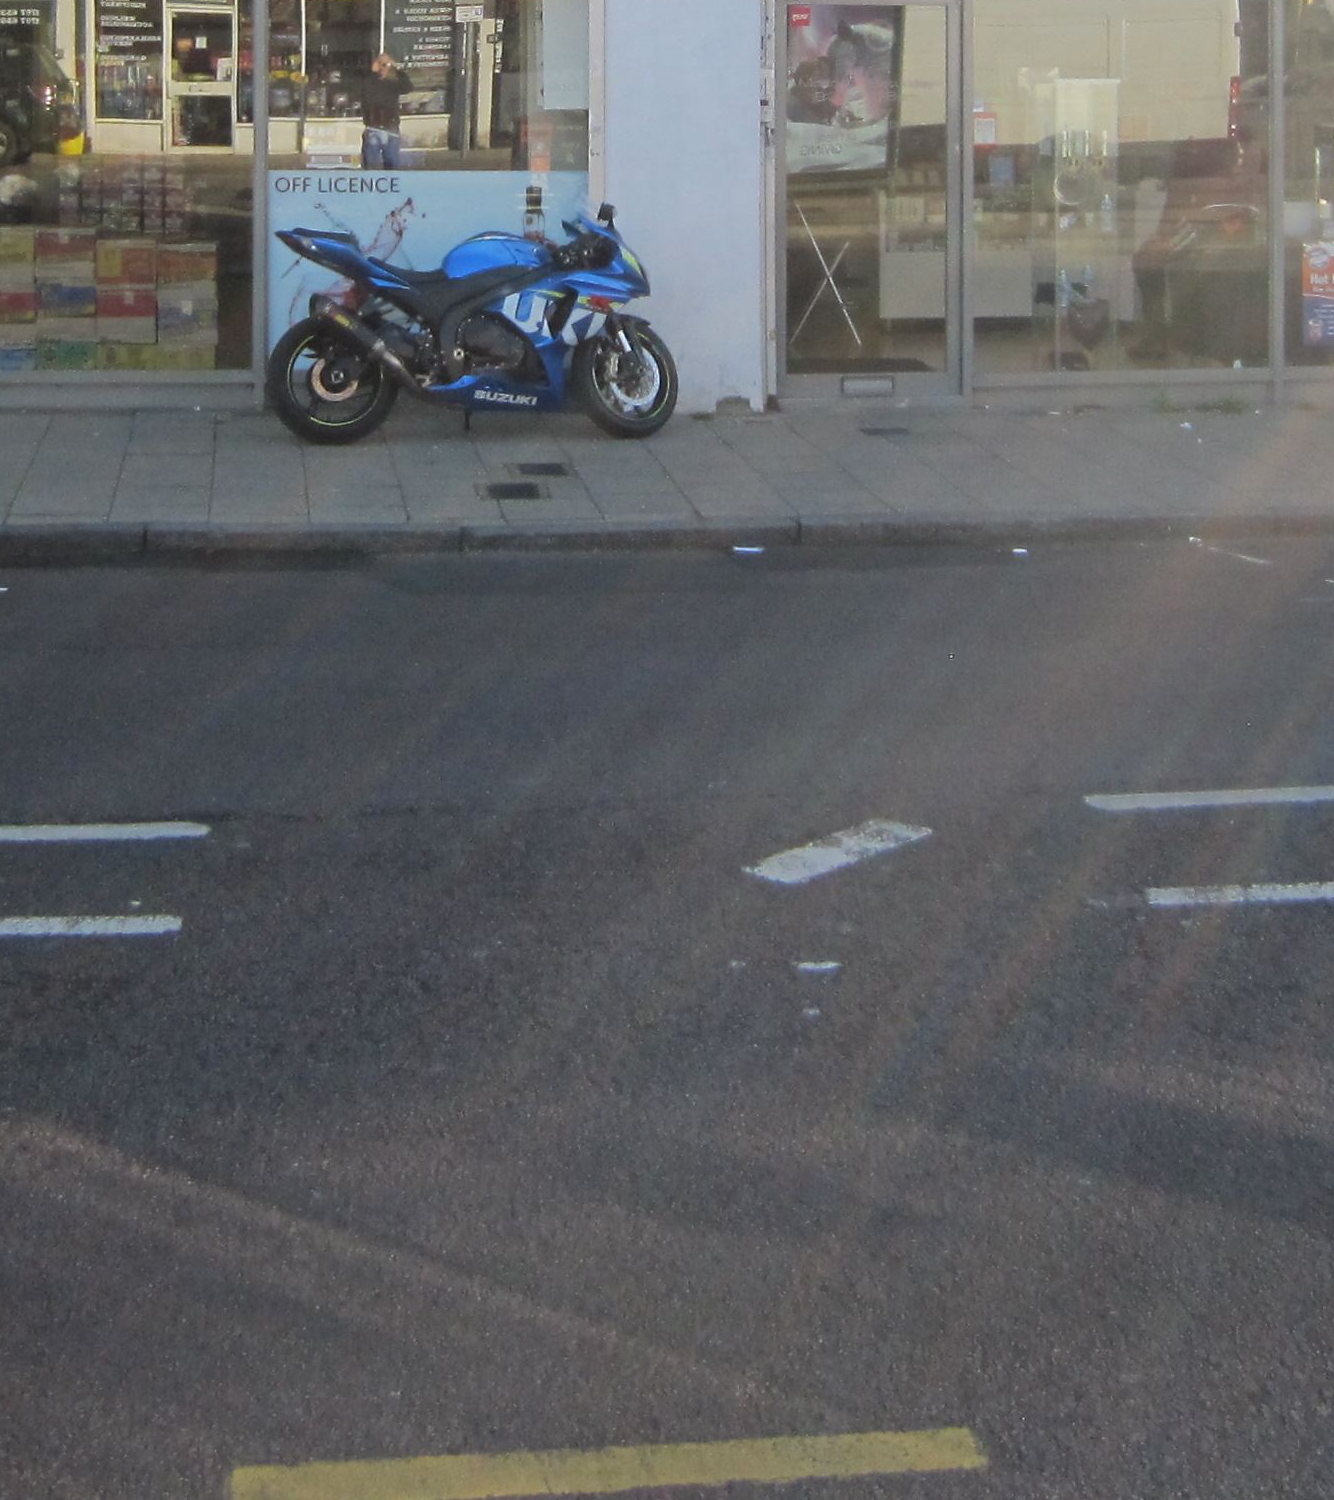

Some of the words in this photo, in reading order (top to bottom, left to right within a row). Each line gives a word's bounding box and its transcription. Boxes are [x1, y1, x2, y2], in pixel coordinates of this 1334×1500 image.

[274, 177, 312, 193] OFF
[317, 177, 401, 194] LICENCE
[473, 389, 539, 406] SUZUKI
